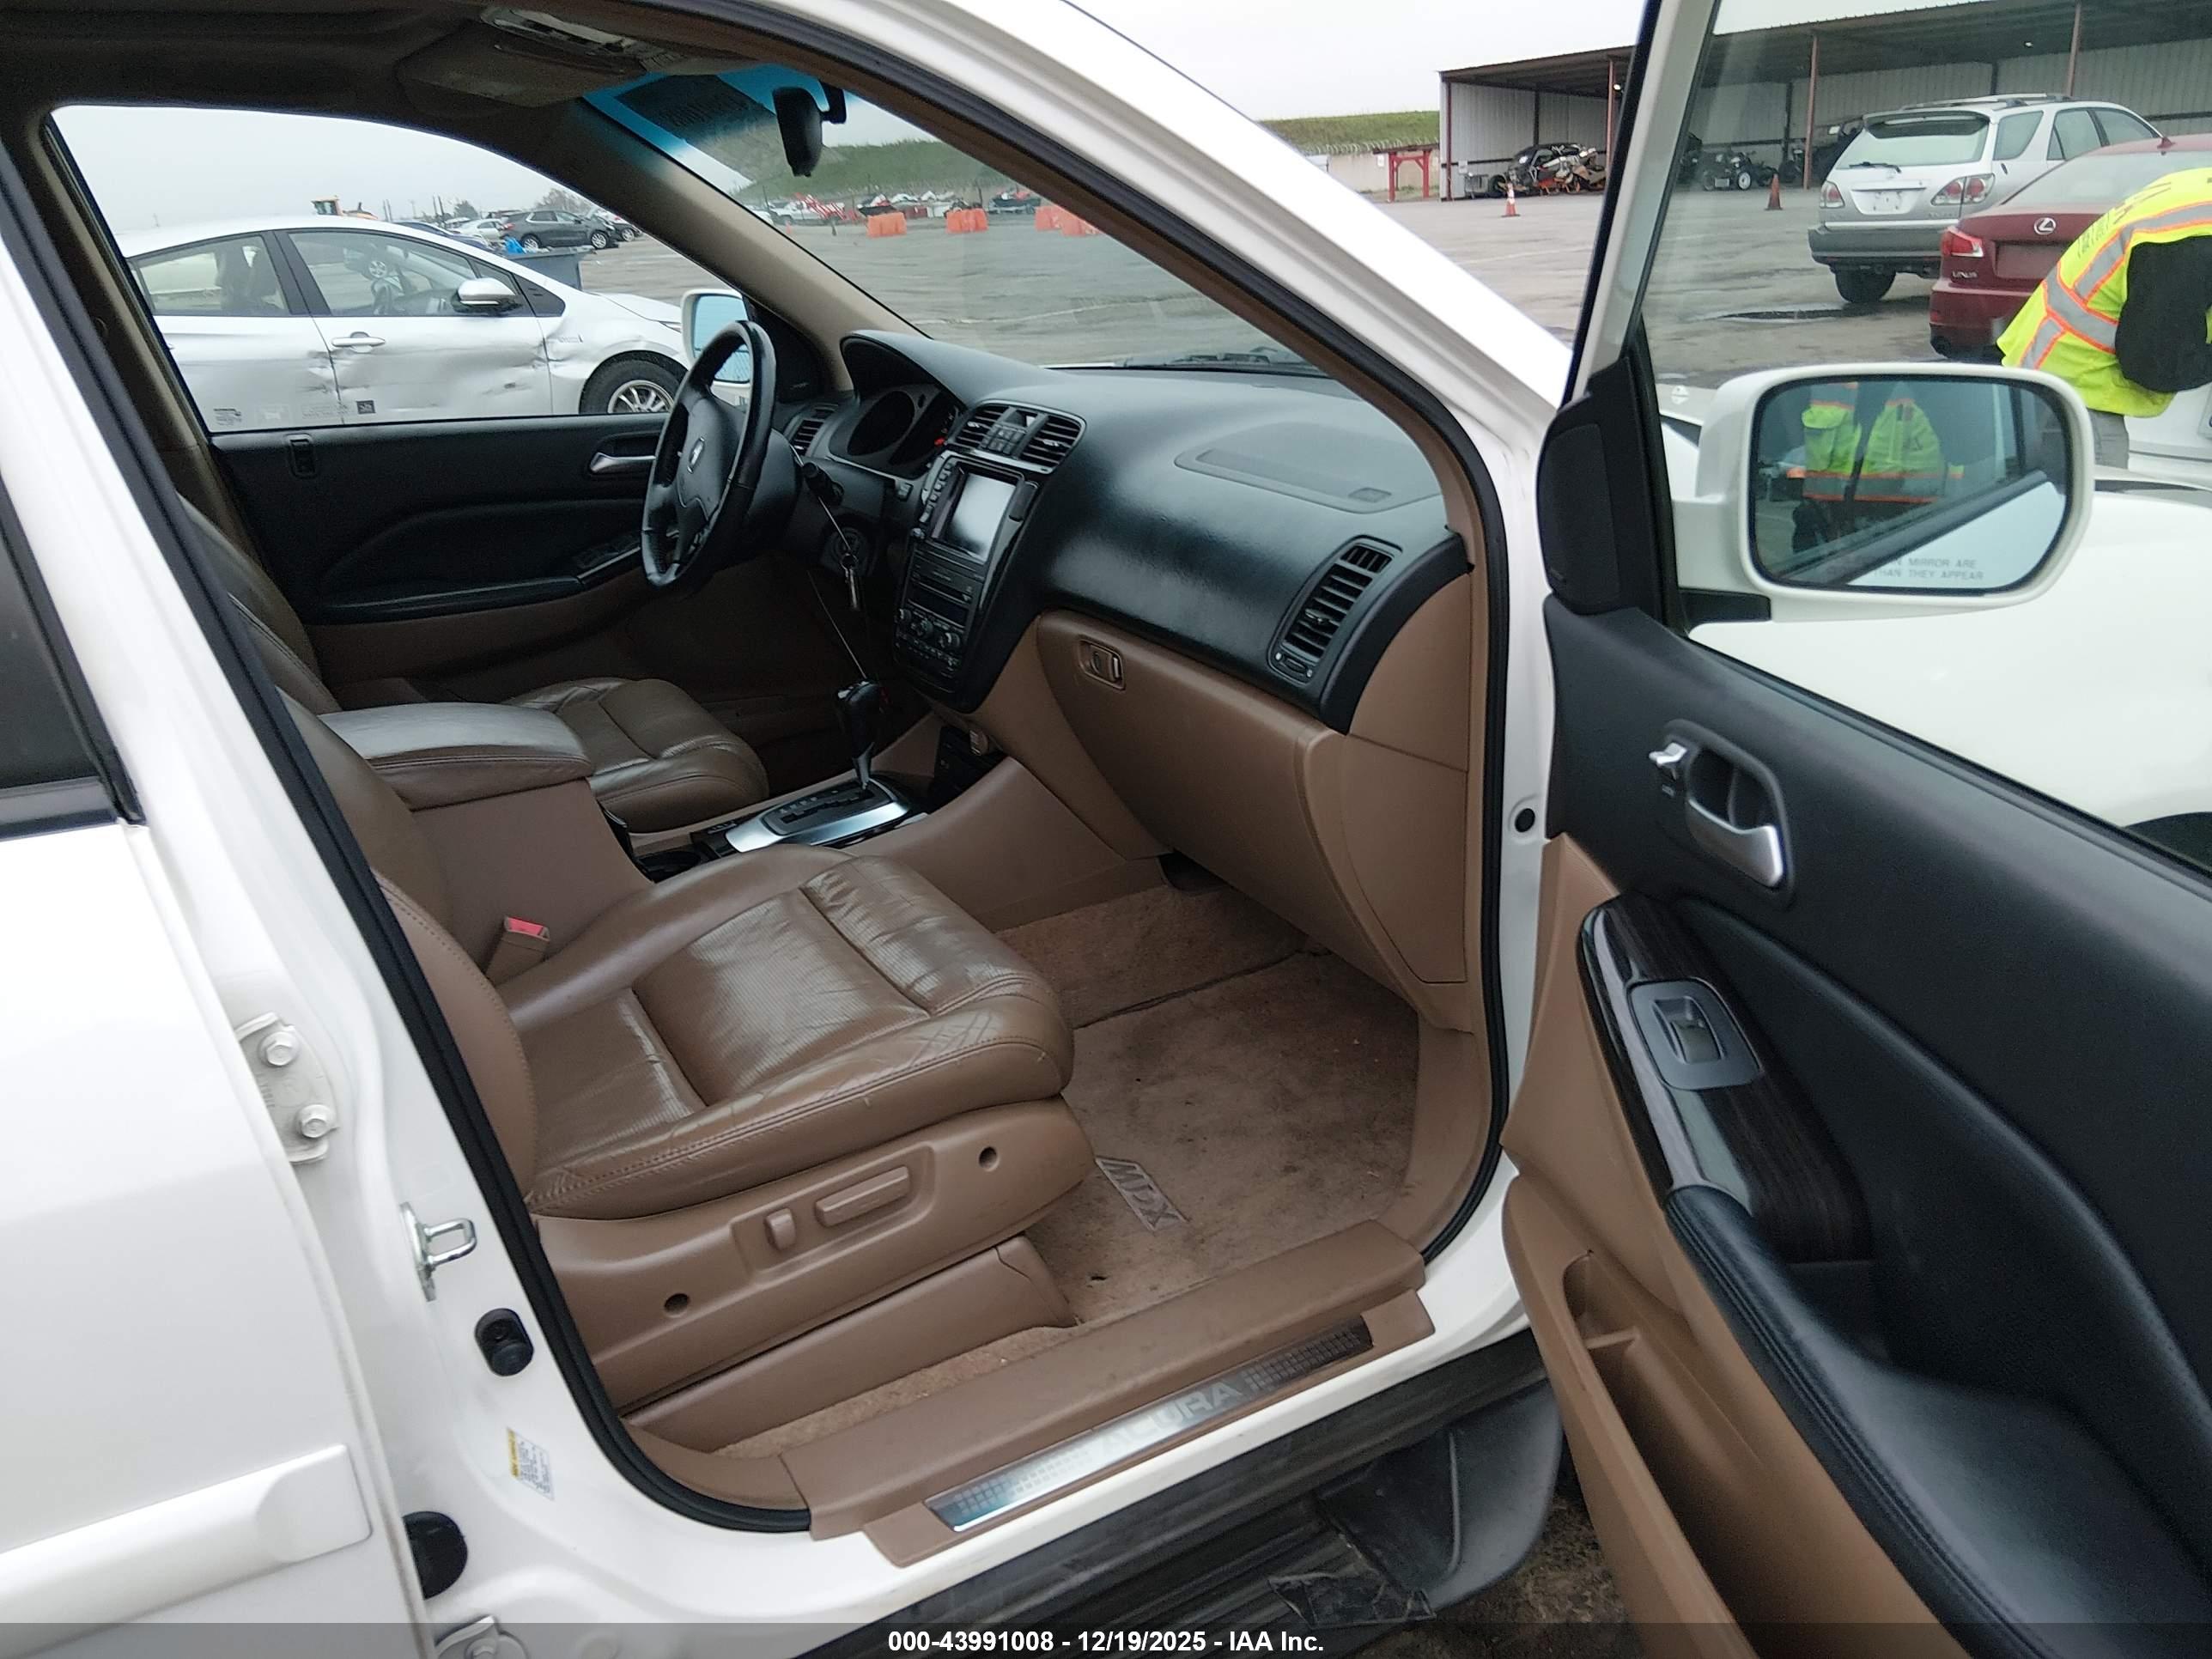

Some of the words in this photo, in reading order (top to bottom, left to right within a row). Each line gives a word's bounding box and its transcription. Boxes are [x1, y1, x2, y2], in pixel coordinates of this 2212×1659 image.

[1908, 557, 1950, 568] MIRROR
[1954, 559, 1977, 569] ARE
[1908, 569, 1934, 579] THEY
[1941, 570, 1984, 580] APPEAR
[1100, 1381, 1243, 1457] ACURA
